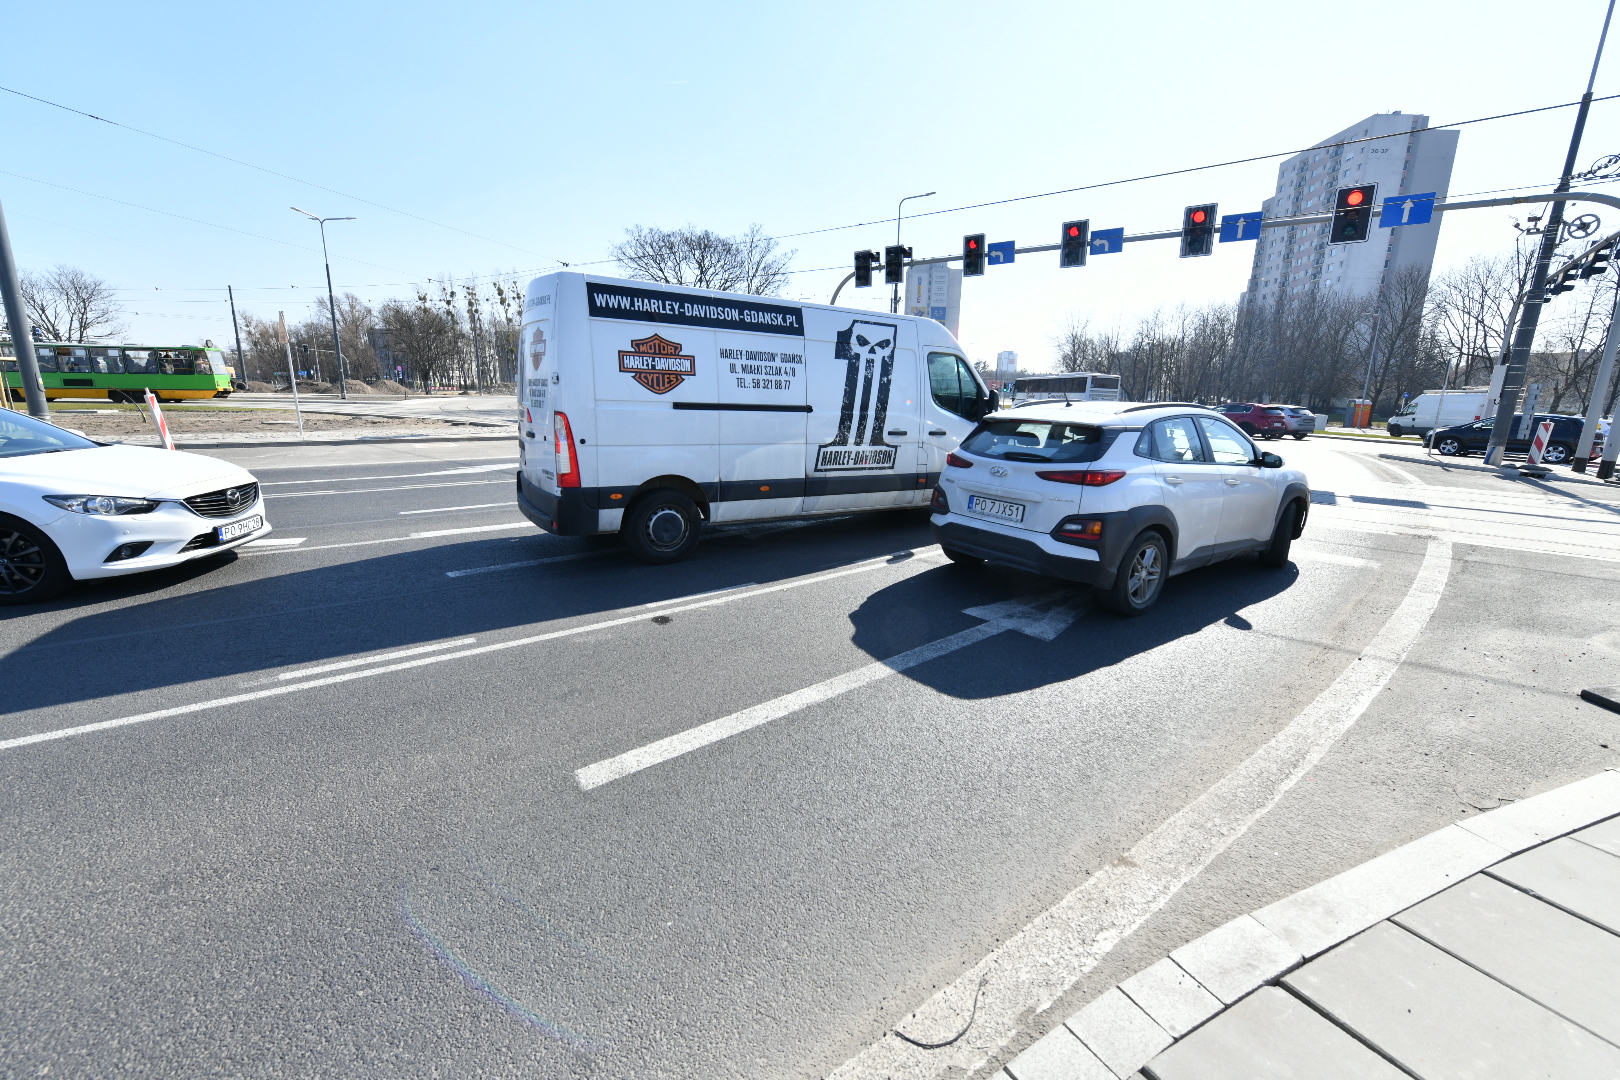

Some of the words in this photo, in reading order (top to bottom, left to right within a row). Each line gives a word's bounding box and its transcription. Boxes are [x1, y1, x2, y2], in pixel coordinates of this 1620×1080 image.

[593, 292, 799, 328] WWW.HARLEY-DAVIDSON-GDANSK.PL
[639, 338, 675, 355] MOTOR
[623, 355, 691, 372] HARLEY-DAVIDSON
[729, 362, 740, 374] UL.
[764, 365, 783, 377] SZLAK
[783, 366, 796, 377] 4/8
[641, 373, 677, 390] CYCLES
[735, 377, 751, 389] TEL.:
[752, 378, 760, 389] 58
[762, 378, 773, 390] 321
[774, 379, 783, 390] 88
[783, 379, 791, 390] 77
[820, 449, 894, 467] HARLEY-DAVIDSON
[974, 498, 987, 511] PO
[988, 501, 1020, 518] 7JX51
[224, 525, 236, 538] PO
[237, 517, 260, 533] 9HC28
